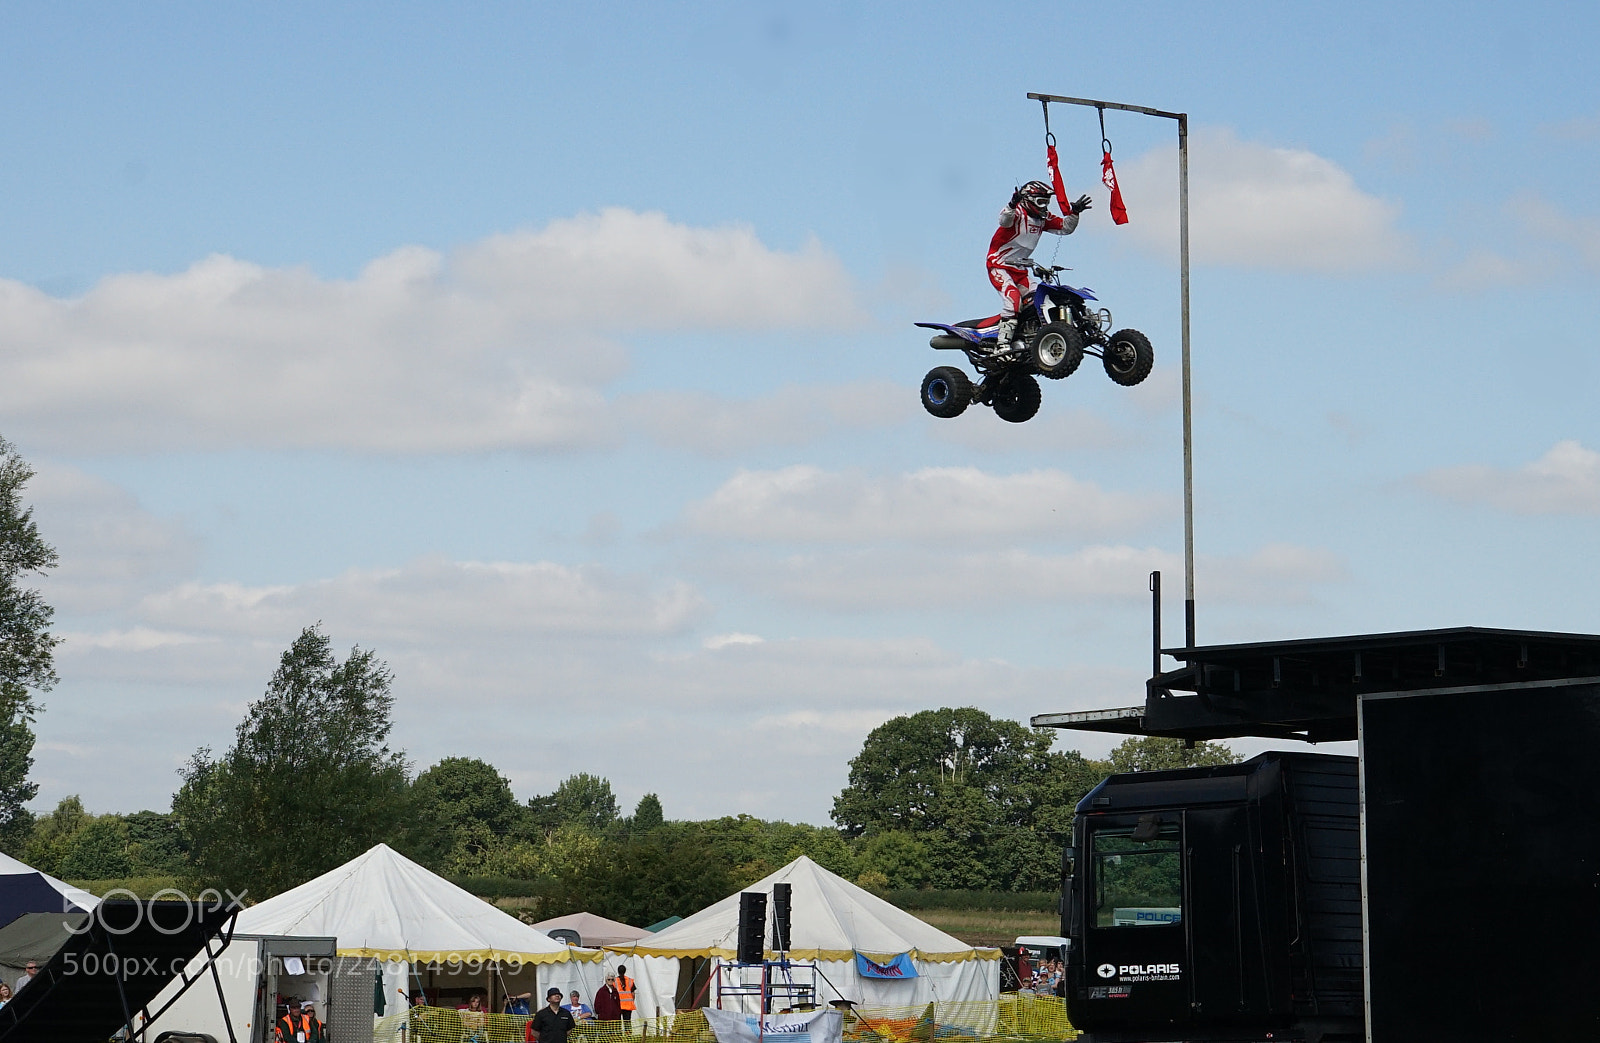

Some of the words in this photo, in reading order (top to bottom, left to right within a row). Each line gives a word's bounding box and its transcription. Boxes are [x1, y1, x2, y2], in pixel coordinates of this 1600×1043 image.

[1136, 912, 1180, 922] POLICE
[1119, 964, 1180, 975] POLARIS
[1119, 974, 1180, 982] www.polaris-britain.com
